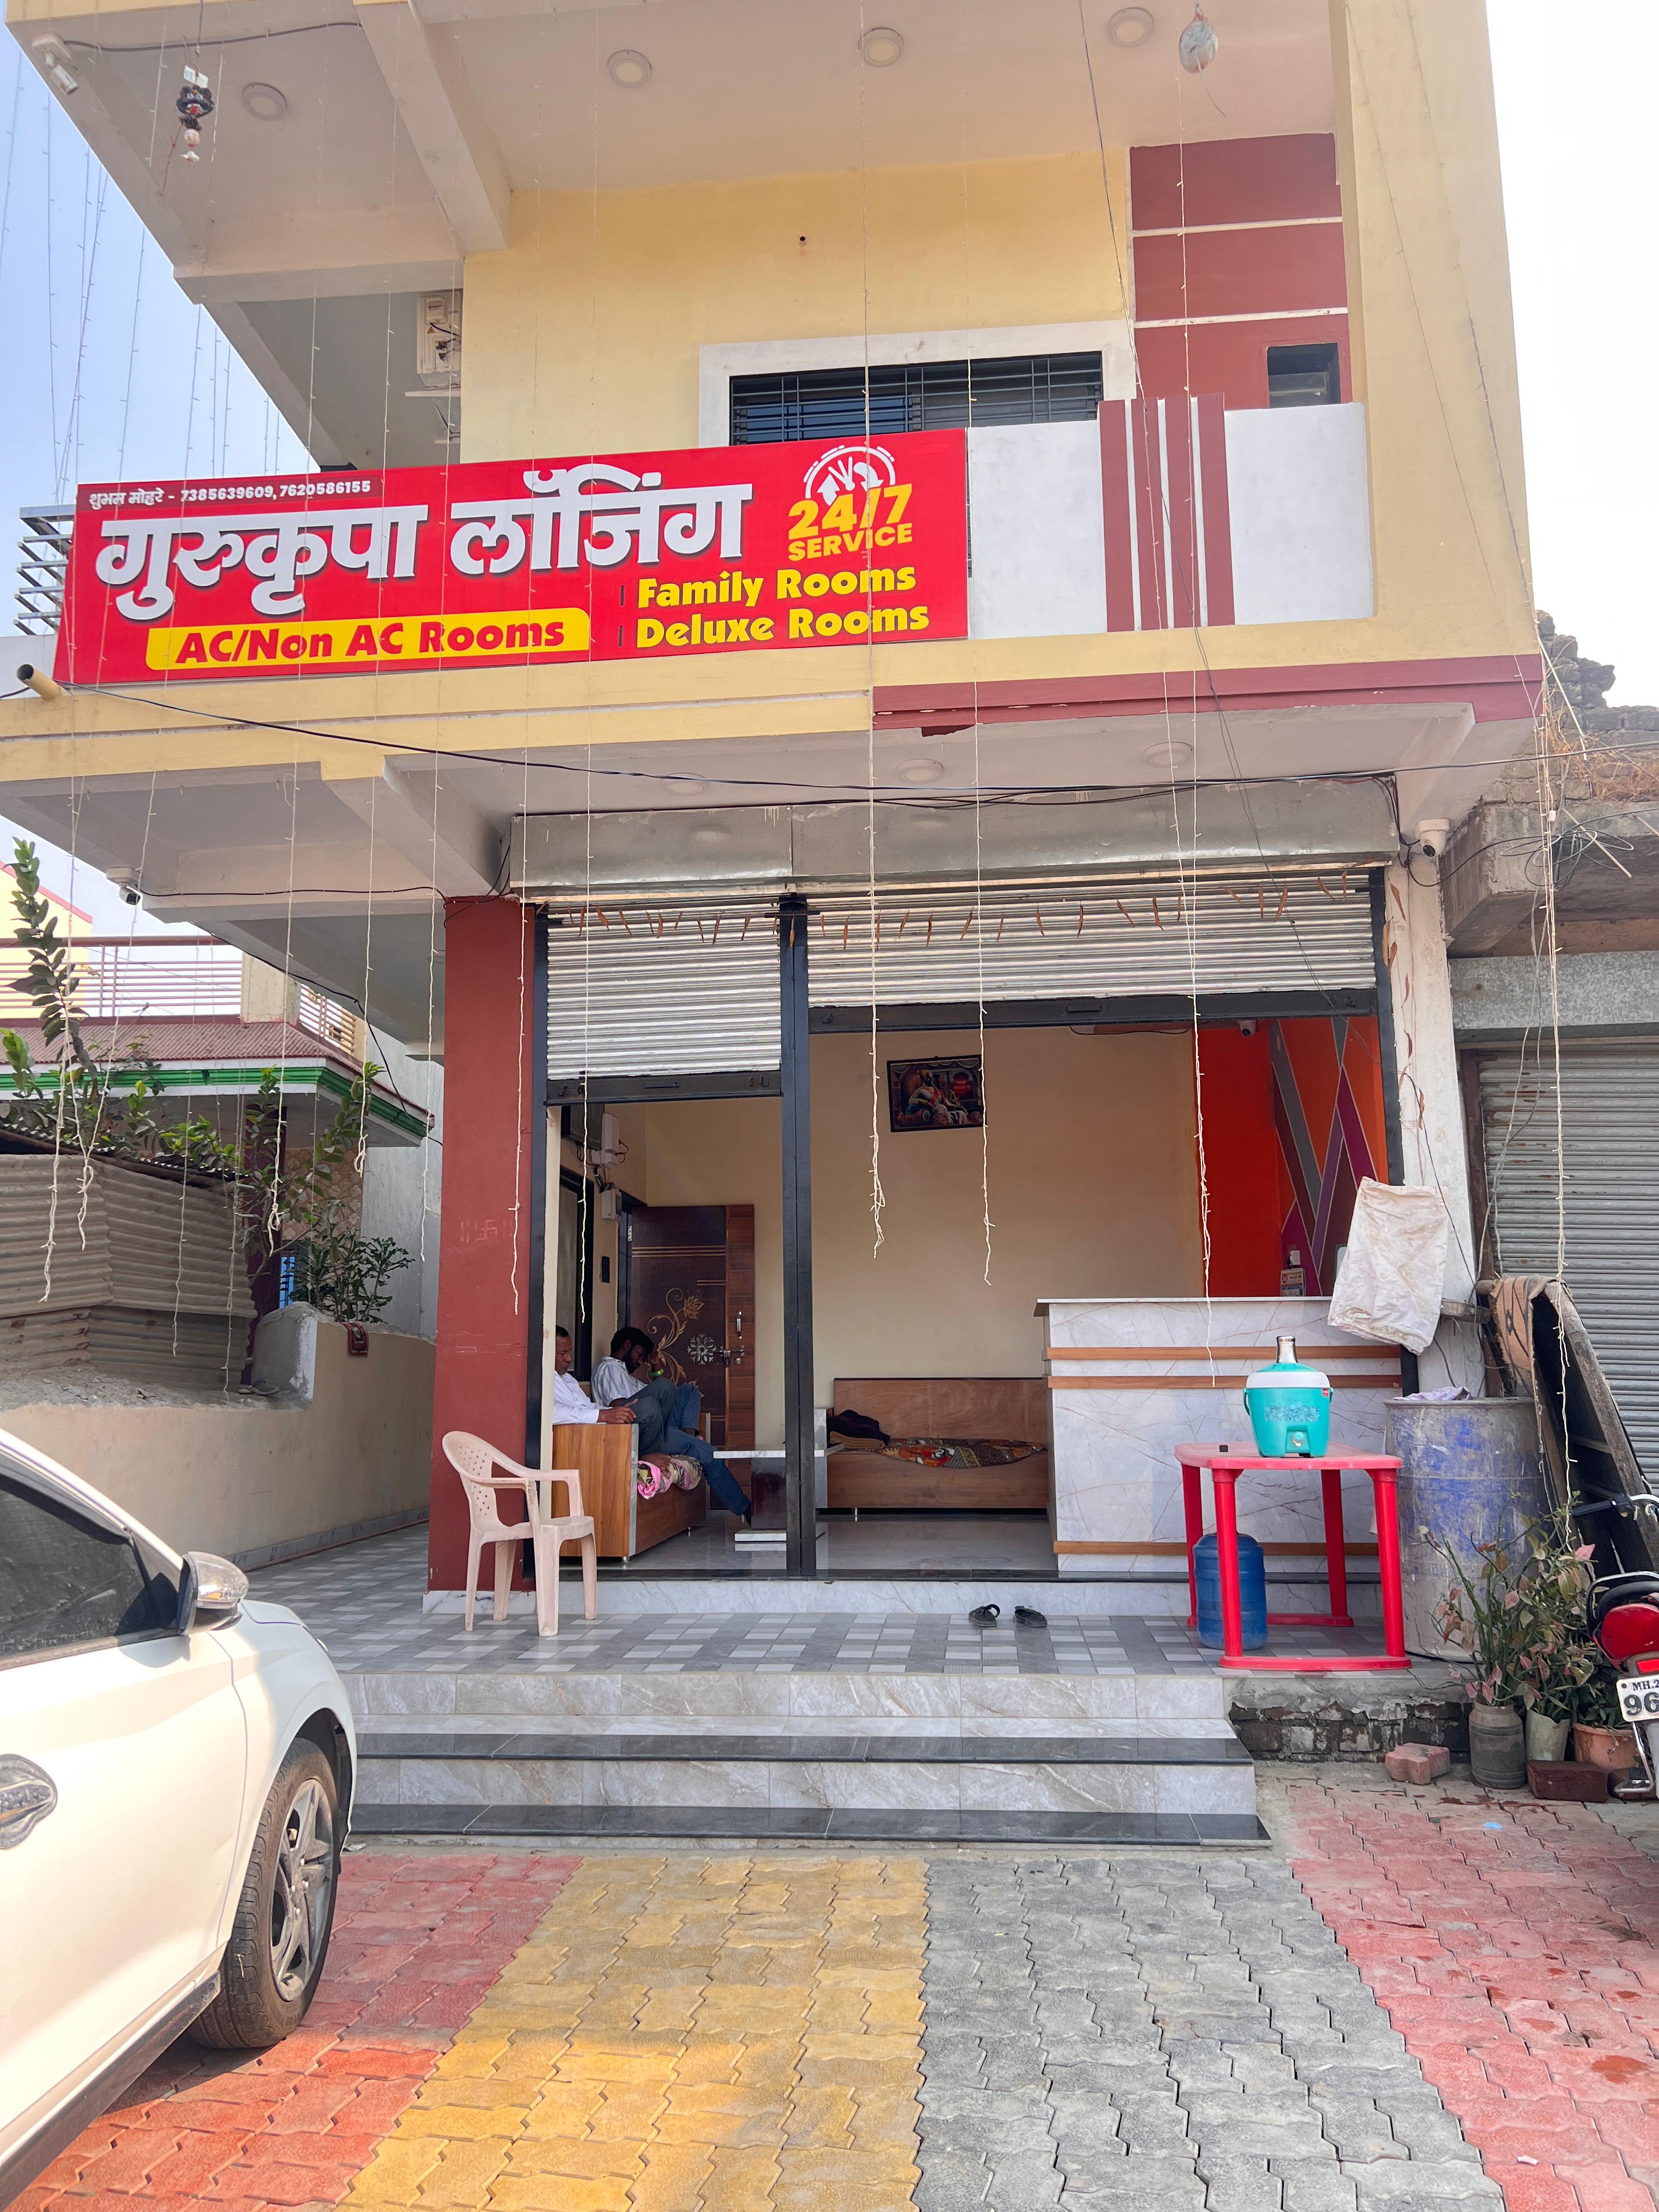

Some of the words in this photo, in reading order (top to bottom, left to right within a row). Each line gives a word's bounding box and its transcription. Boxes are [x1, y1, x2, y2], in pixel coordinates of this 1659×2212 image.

[89, 493, 127, 510] शुभम
[128, 487, 165, 506] मोहरे
[280, 481, 370, 497] 7620586155
[788, 483, 912, 540] 24/7
[96, 505, 428, 620] गुरुकृपा
[450, 464, 752, 574] लॉजिंग
[788, 522, 912, 561] SERVICE
[638, 571, 764, 608] Family
[777, 567, 916, 599] Rooms
[176, 629, 332, 664] AC/Non
[345, 623, 404, 656] AC
[419, 619, 565, 653] Rooms
[637, 614, 774, 648] Deluxe
[789, 606, 929, 639] Rooms
